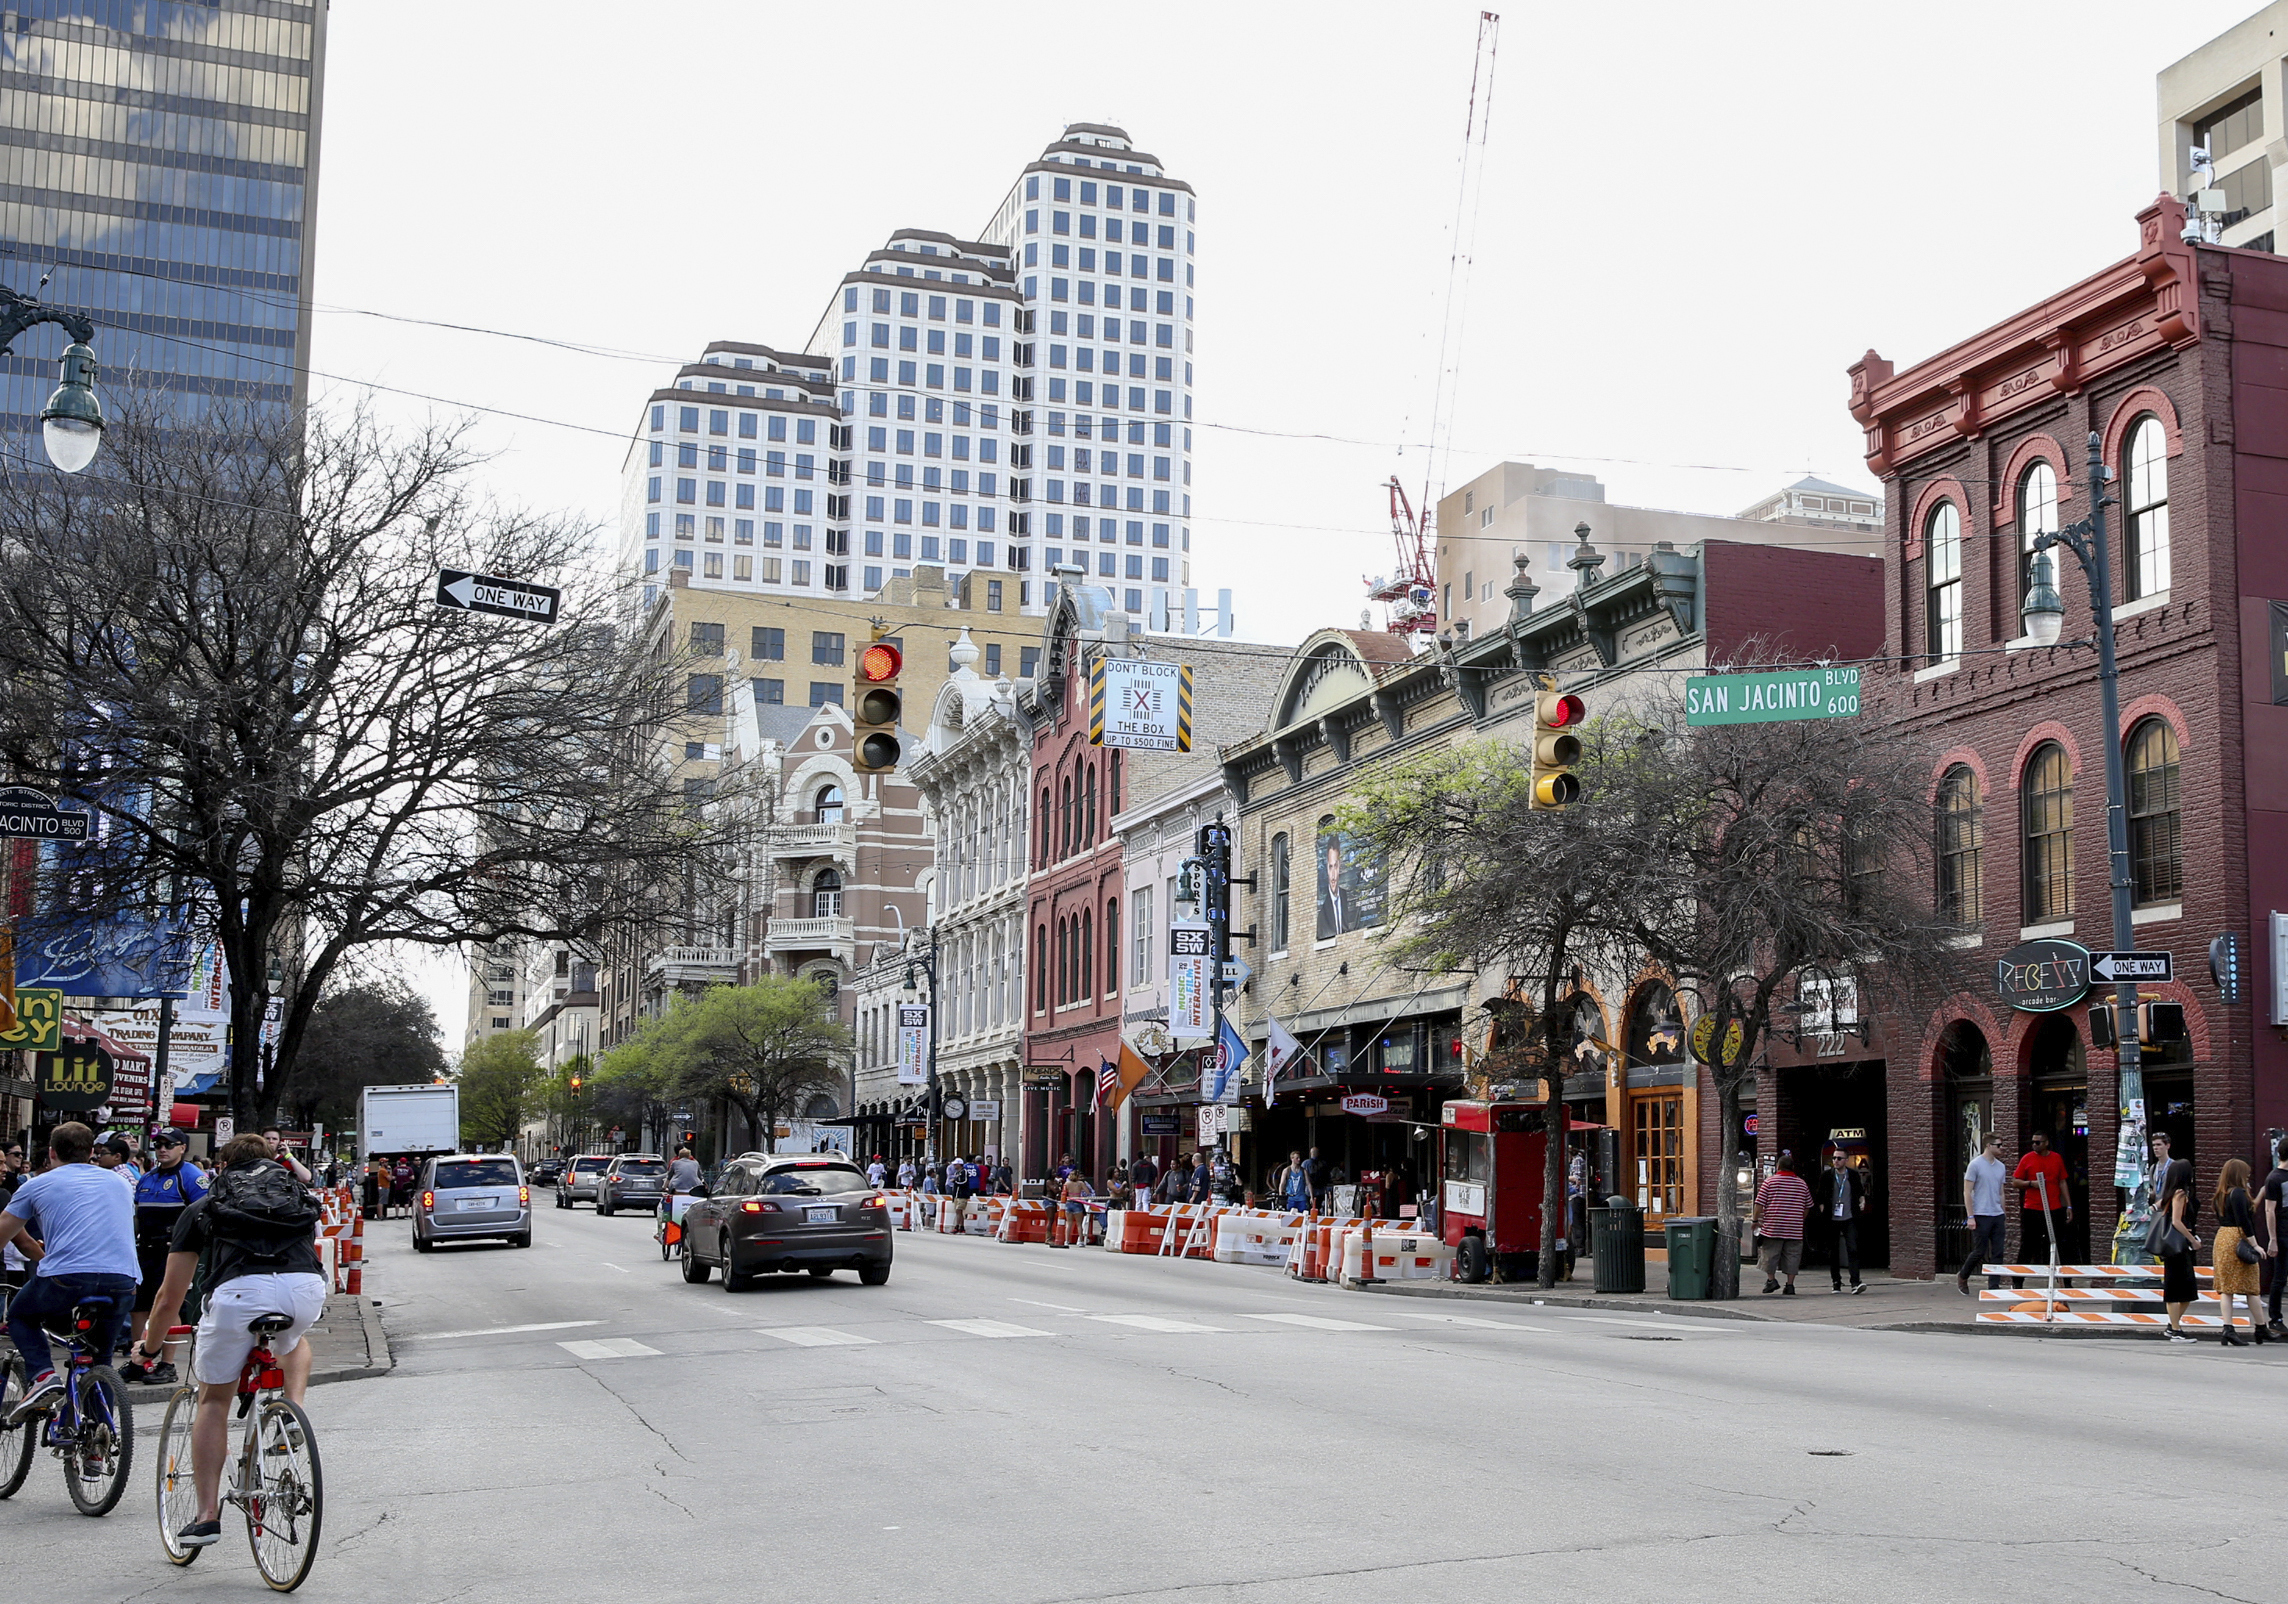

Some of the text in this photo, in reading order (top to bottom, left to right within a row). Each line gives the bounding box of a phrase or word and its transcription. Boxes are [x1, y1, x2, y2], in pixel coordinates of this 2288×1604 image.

[474, 586, 546, 611] ONE WAY
[1108, 662, 1177, 678] DON'T BLOCK
[1825, 670, 1858, 686] BLVD
[1688, 681, 1821, 714] SAN JACINTO
[1827, 695, 1858, 714] 600
[1117, 721, 1165, 734] THE BOX
[1106, 735, 1175, 749] UP TO $500 FINE
[18, 789, 46, 801] STREET
[21, 802, 51, 810] DISTRICT
[0, 815, 59, 834] ACINTO
[61, 819, 85, 827] BLVD
[63, 827, 81, 835] 500
[1193, 864, 1201, 915] SPORTS
[2114, 961, 2163, 973] ONE WAY
[1186, 968, 1194, 993] FILM
[1178, 976, 1186, 1010] MUSIC
[1193, 959, 1201, 1026] INTERACTIVE
[107, 1028, 212, 1042] TRADING OMPANY
[1816, 1033, 1846, 1058] 222
[52, 1056, 101, 1082] Lit
[121, 1059, 146, 1073] MART
[1025, 1067, 1062, 1075] FRIENDS
[44, 1078, 107, 1095] Lounge
[113, 1073, 148, 1085] UVENIRS
[1835, 1129, 1864, 1138] ATM
